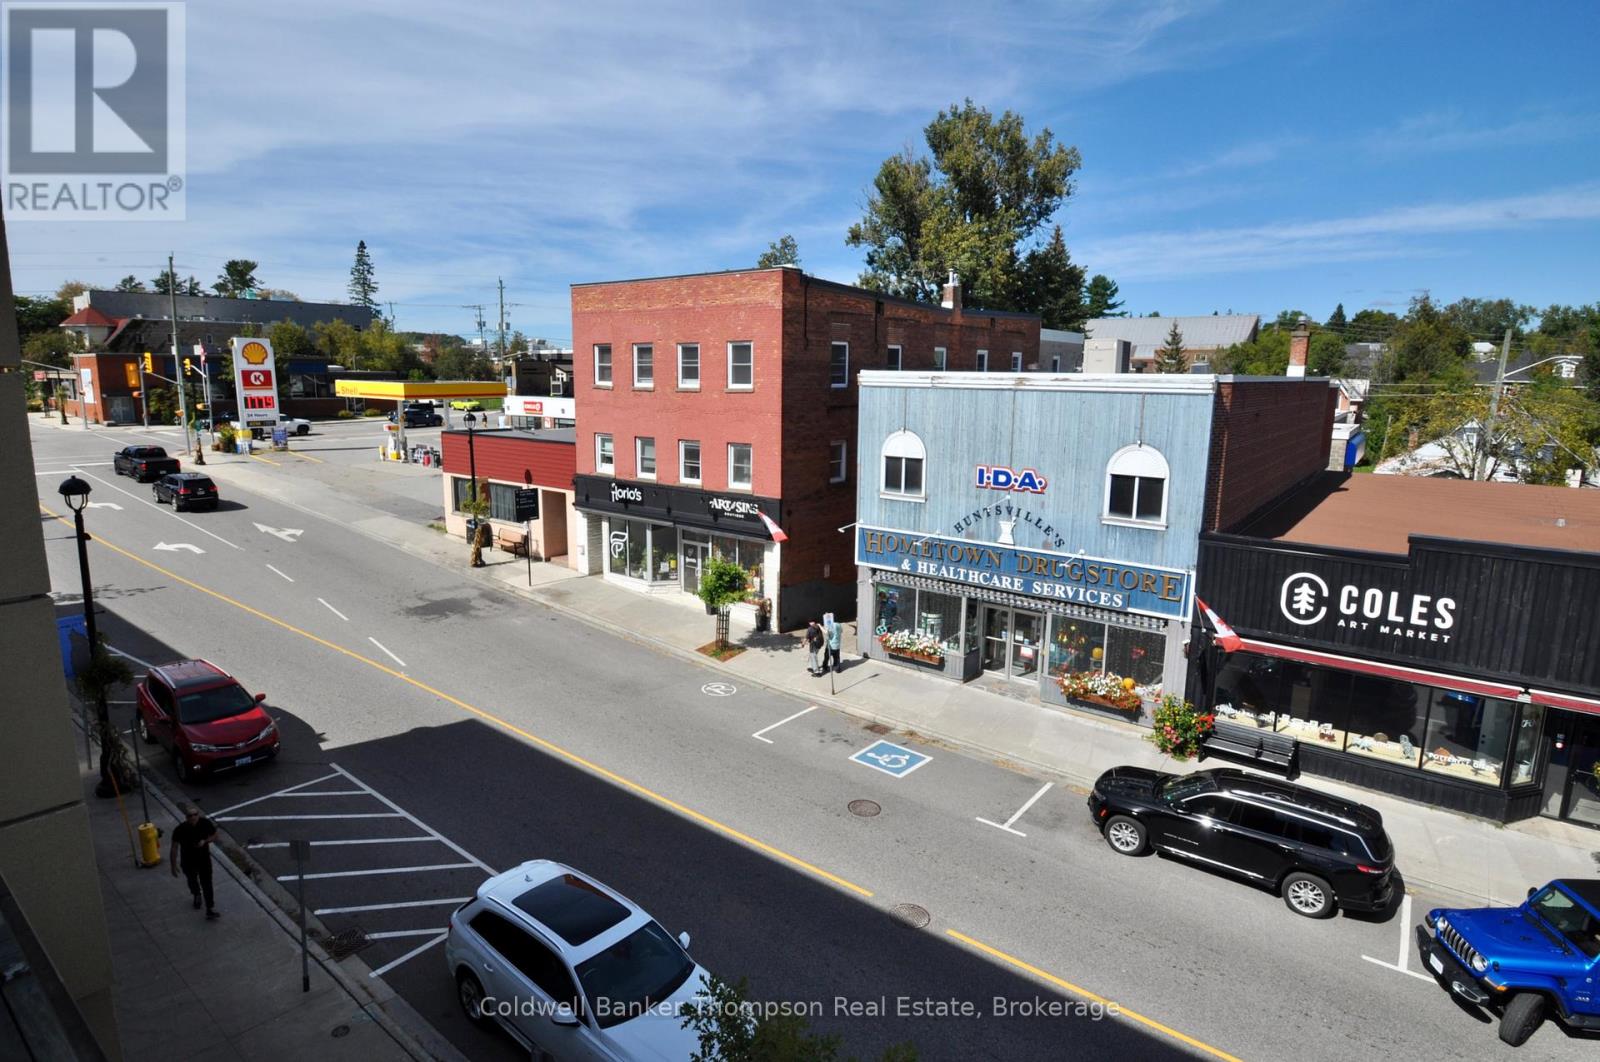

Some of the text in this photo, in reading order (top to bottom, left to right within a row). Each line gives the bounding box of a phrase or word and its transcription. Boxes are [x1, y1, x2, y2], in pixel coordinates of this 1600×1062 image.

[341, 386, 358, 395] Shell
[954, 505, 1065, 548] HUNTSVILLE'S
[866, 531, 1183, 603] HOMETOWN DRUGSTORE
[901, 558, 1123, 608] & HEALTHCARE SERVICES
[1339, 585, 1456, 629] COLES
[1337, 619, 1451, 644] ART MARKET
